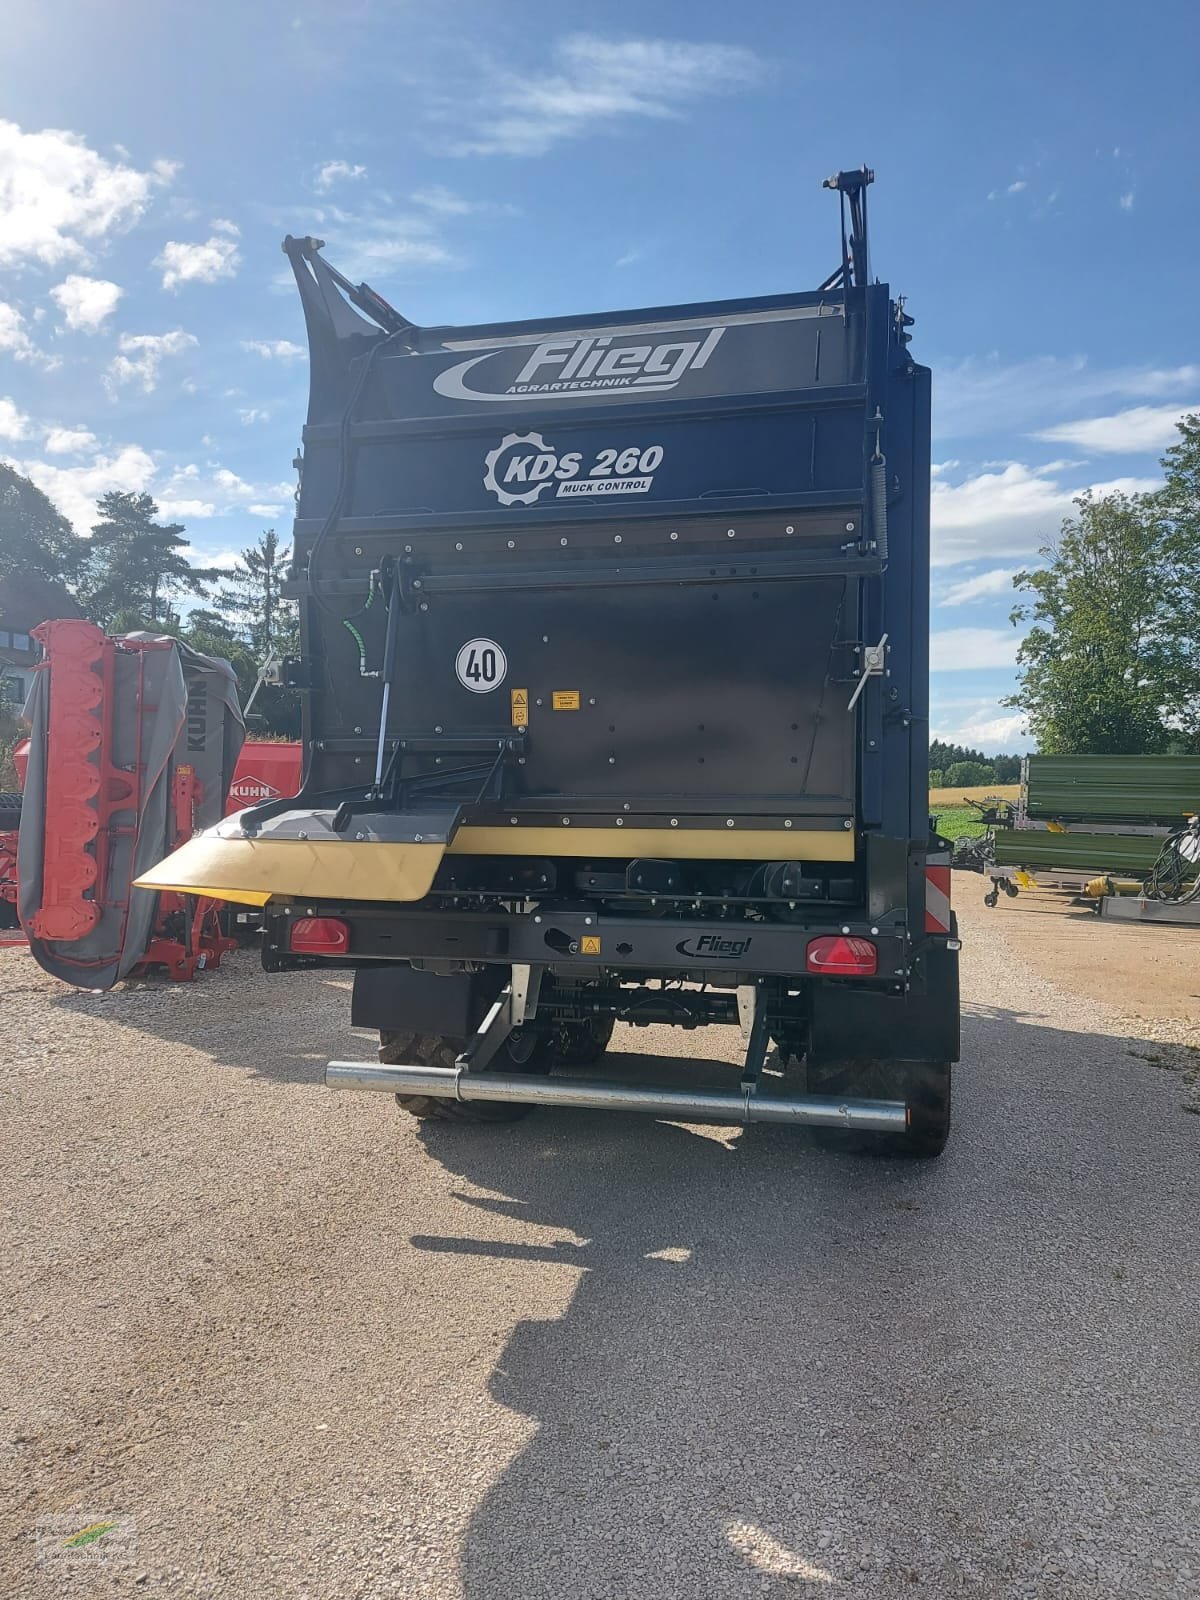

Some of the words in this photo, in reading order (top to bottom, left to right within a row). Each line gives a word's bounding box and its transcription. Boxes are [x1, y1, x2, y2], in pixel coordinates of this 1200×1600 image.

[515, 327, 727, 385] Fliegl
[505, 377, 634, 394] AGRARTECHNIK
[503, 452, 583, 482] KDS
[588, 446, 664, 476] 260
[562, 483, 594, 493] MUCK
[597, 480, 648, 492] CONTROL
[465, 648, 496, 682] 40
[187, 680, 207, 752] KUHN
[230, 786, 271, 797] KUHN
[696, 935, 752, 956] Fliegl
